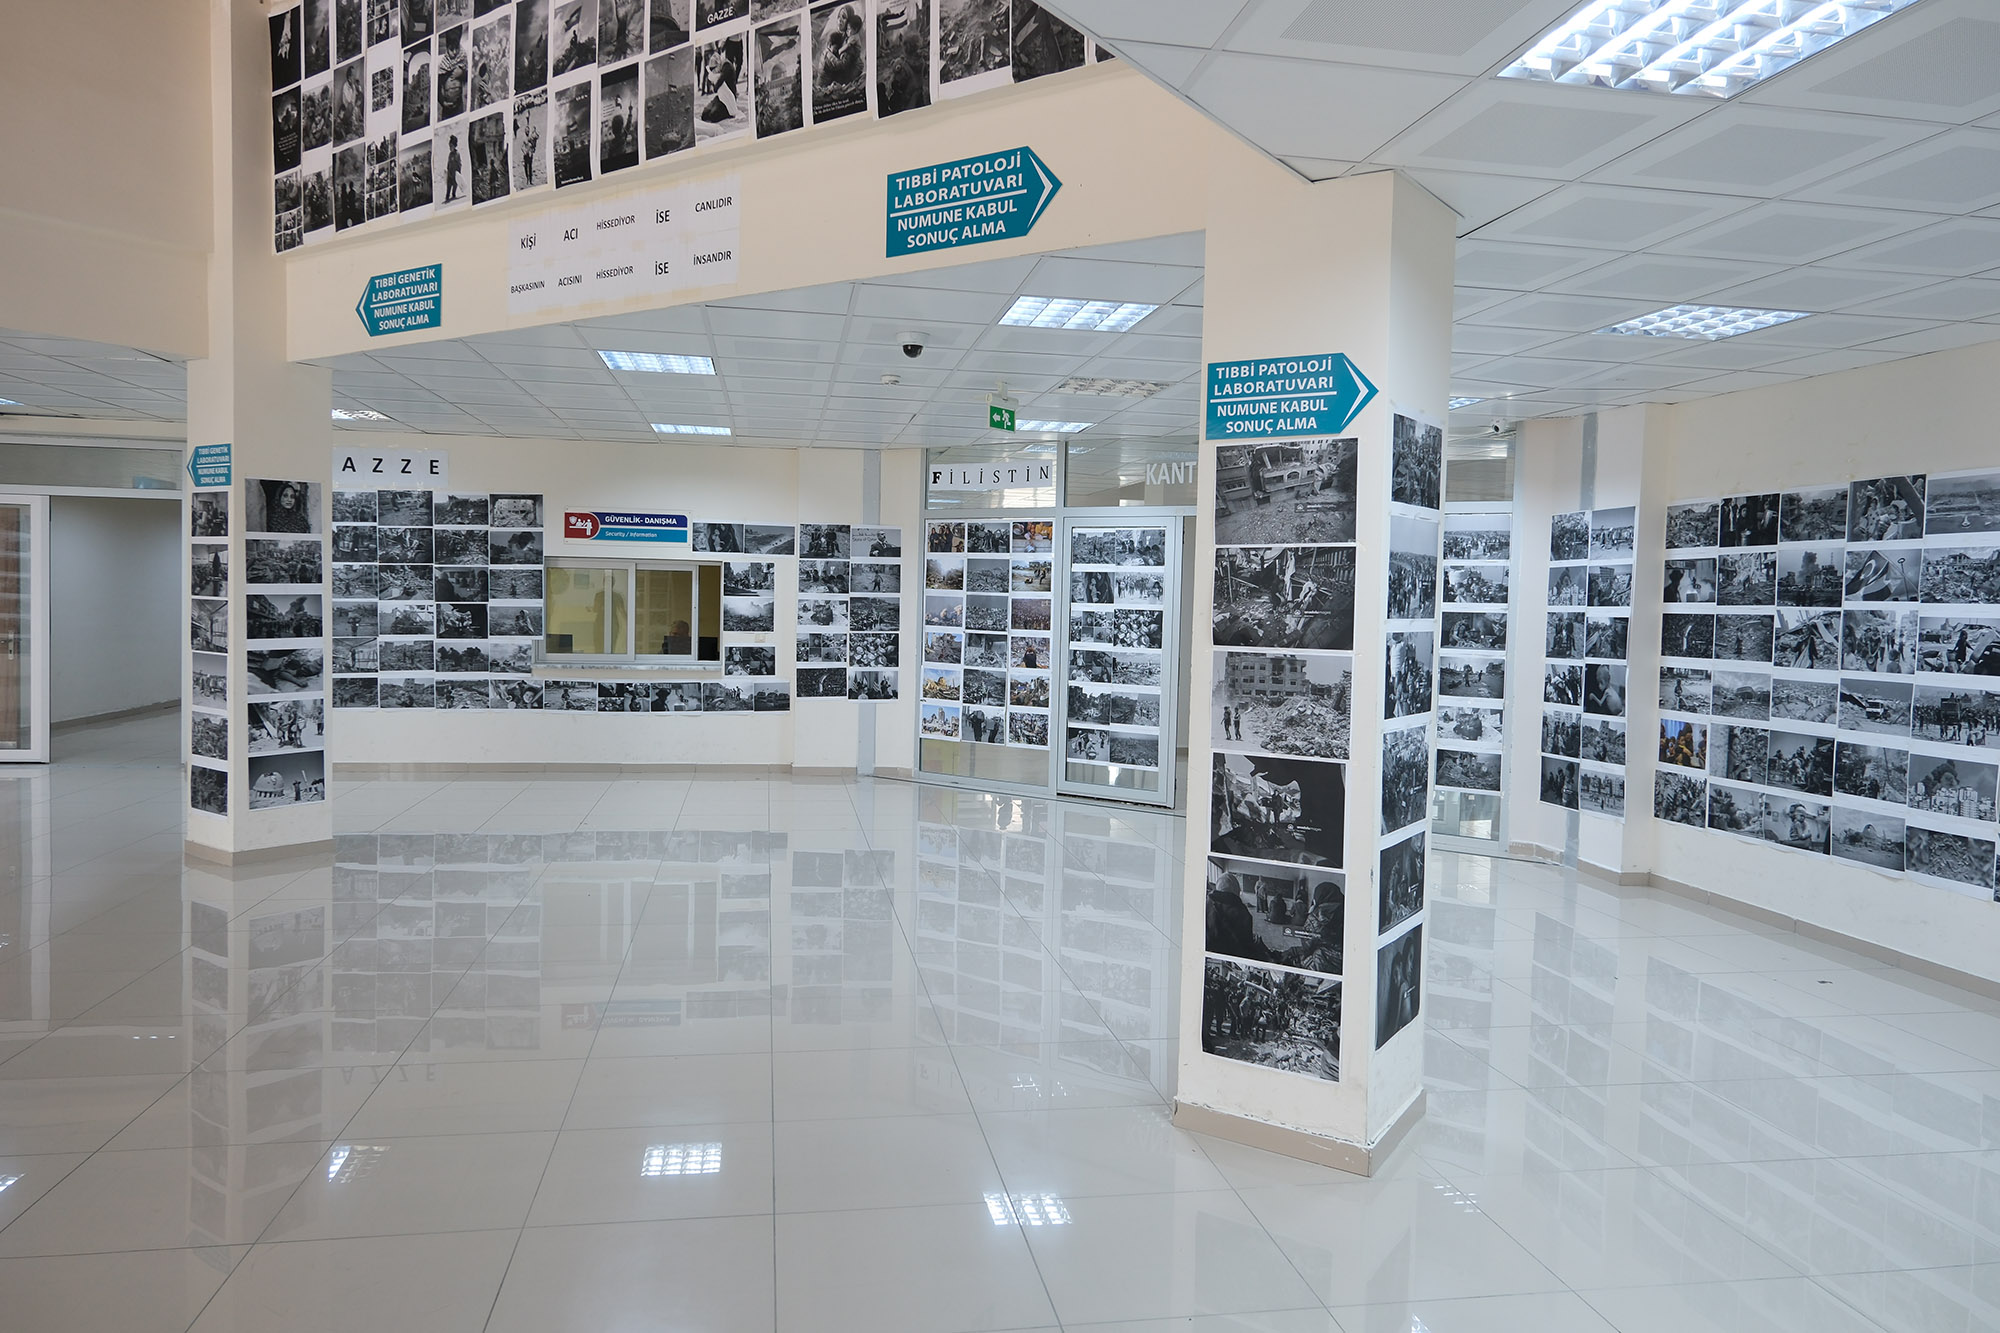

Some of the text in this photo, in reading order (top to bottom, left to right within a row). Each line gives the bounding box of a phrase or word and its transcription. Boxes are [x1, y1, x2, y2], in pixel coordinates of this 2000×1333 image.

[707, 6, 733, 23] GAZZE
[896, 151, 1021, 191] TIBBİ PATOLOJİ
[894, 173, 1023, 209] LABORATUVARI
[520, 196, 733, 250] KİŞİ ACI HİSSEDİYOR İSE CANLIDIR
[897, 199, 1018, 232] NUMUNE KABUL
[907, 220, 1006, 248] SONUÇ ALMA
[375, 267, 436, 289] TIBBİ GENETİK
[510, 250, 732, 294] BAŞKASININ ACISINI HİSSEDİYOR İSE İNSANDIR
[372, 281, 438, 302] LABORATUVARI
[374, 300, 435, 318] NUMUNE KABUL
[379, 314, 429, 330] SONUÇ ALMA
[1216, 356, 1332, 379] TIBBİ PATOLOJİ
[1214, 376, 1333, 396] LABORATUVARI
[1217, 399, 1328, 417] NUMUNE KABUL
[1225, 417, 1317, 434] SONUÇ ALMA
[1146, 461, 1197, 485] KANT
[644, 517, 678, 525] DANIŞMA
[605, 530, 625, 538] Security
